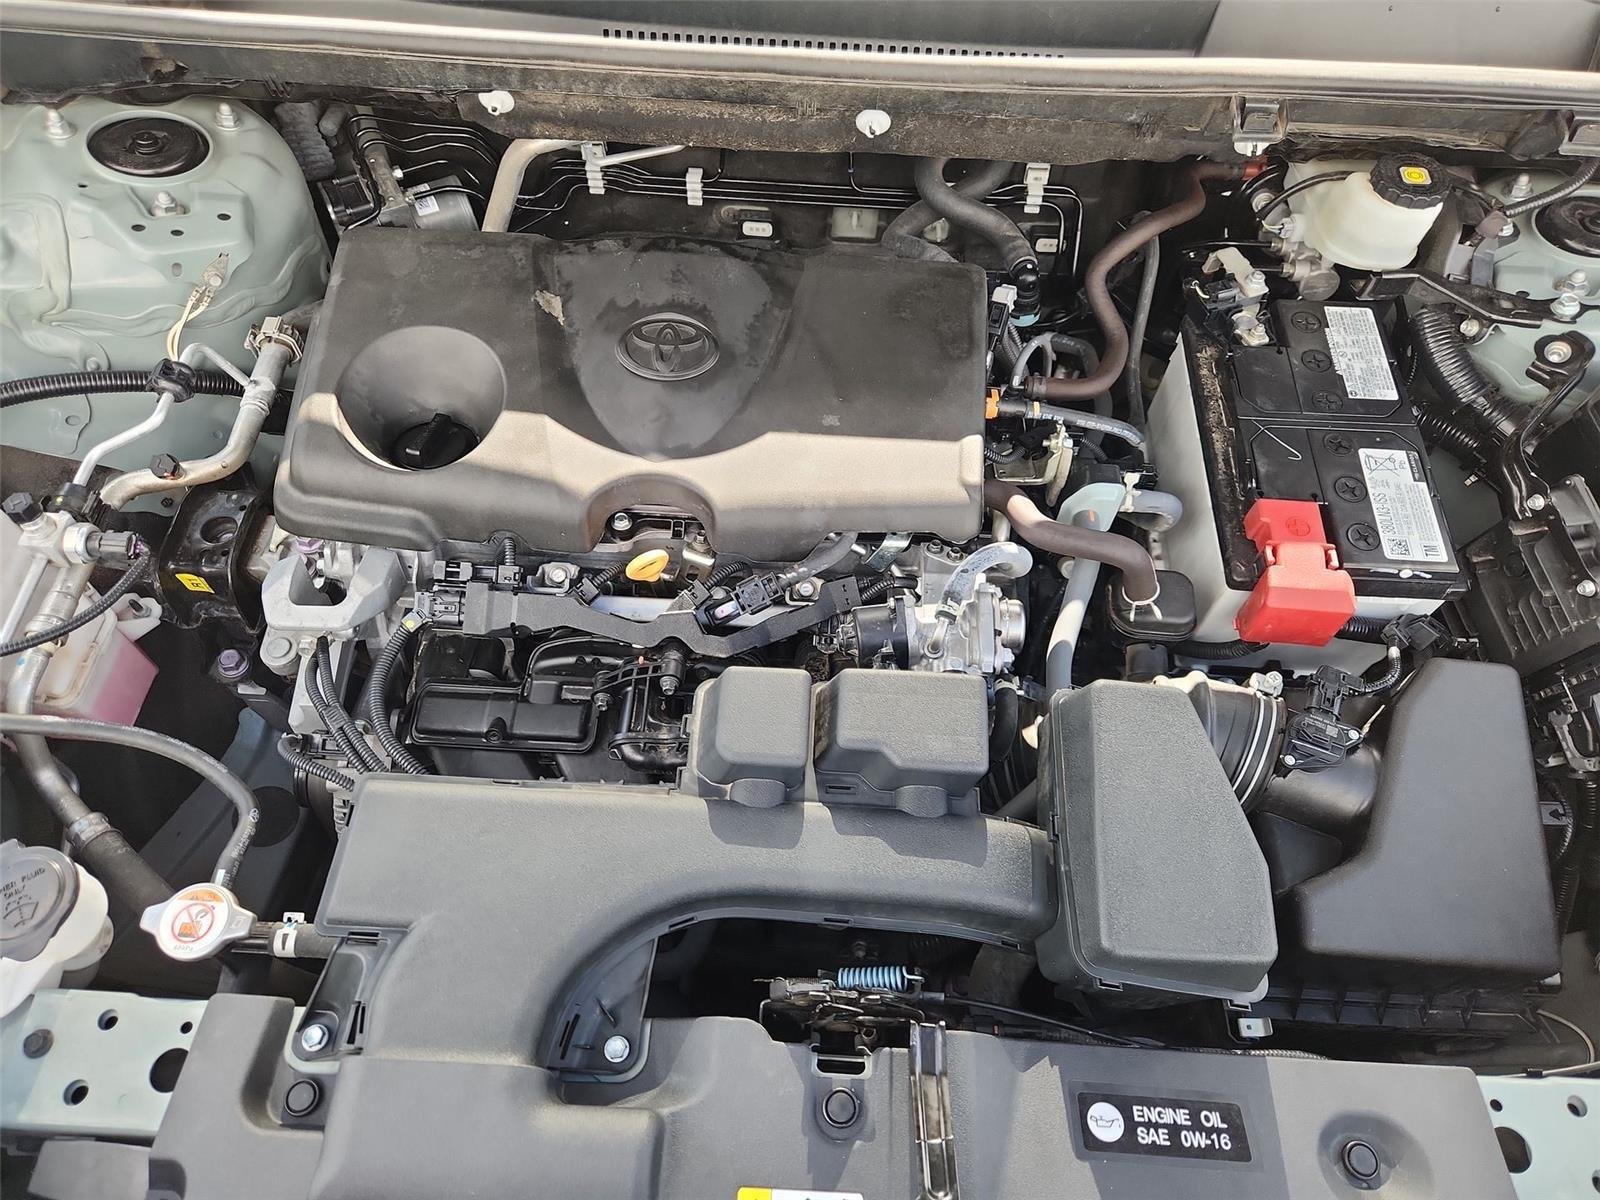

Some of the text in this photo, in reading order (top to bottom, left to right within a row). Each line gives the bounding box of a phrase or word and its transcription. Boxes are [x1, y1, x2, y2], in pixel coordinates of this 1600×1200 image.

[1132, 1105, 1228, 1129] ENGINE OIL
[1136, 1127, 1232, 1150] SAE 0W-16
